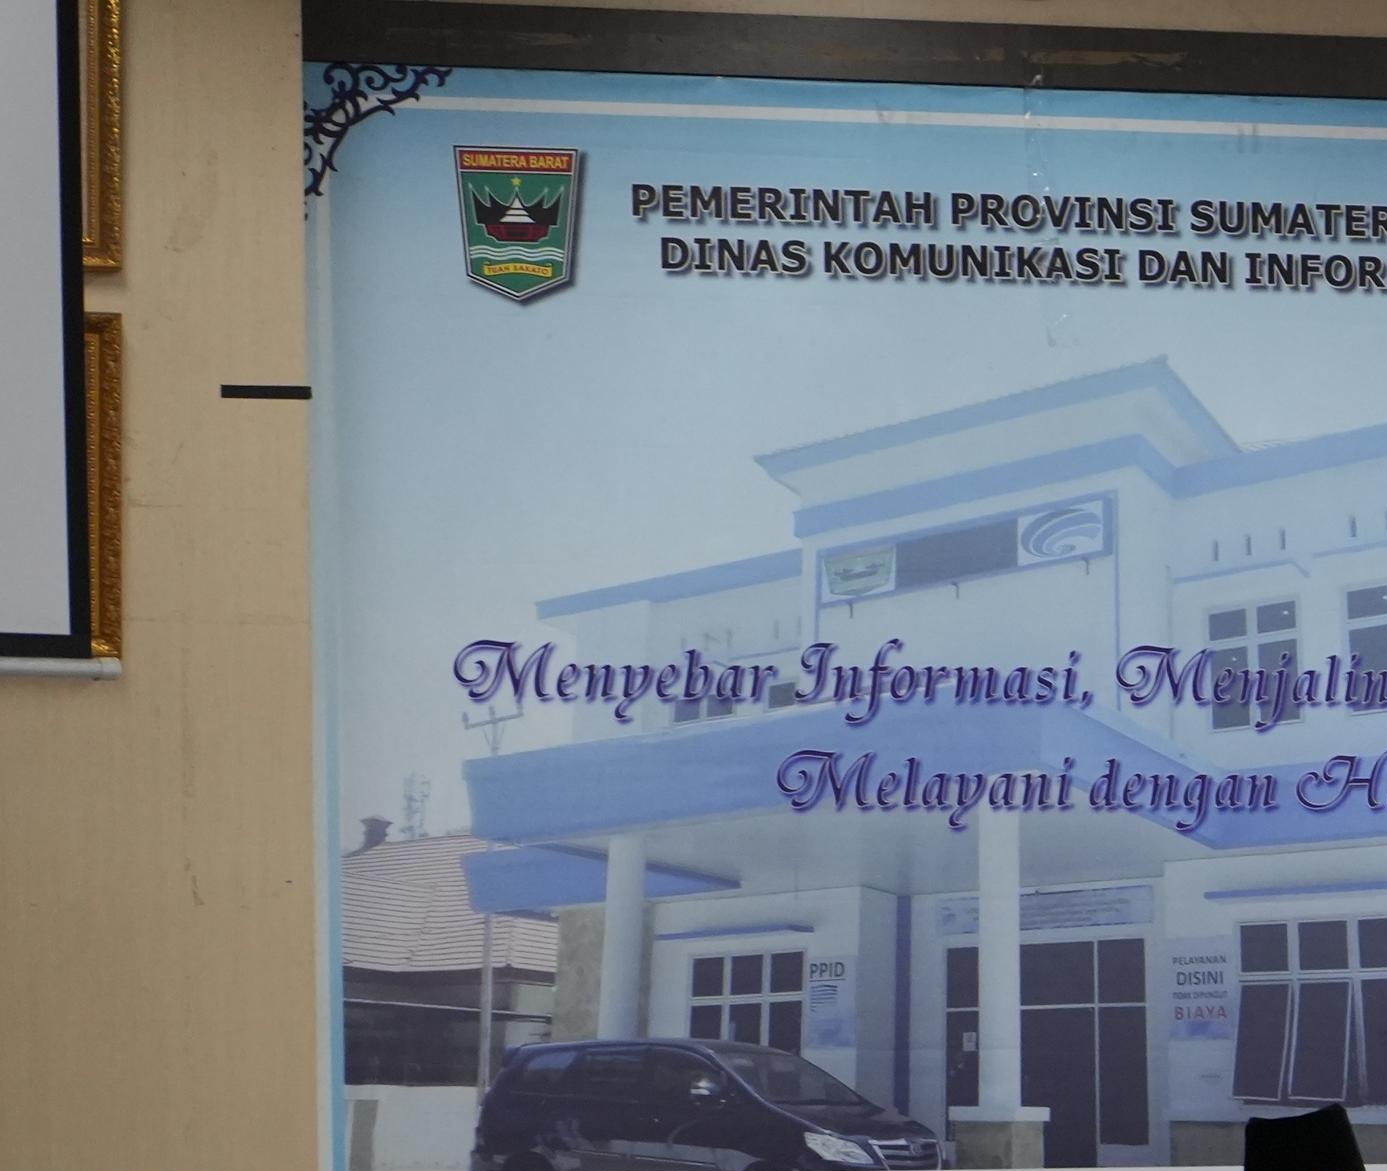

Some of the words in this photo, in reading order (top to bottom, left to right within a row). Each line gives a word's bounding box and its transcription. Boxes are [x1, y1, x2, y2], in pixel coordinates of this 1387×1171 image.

[463, 153, 526, 168] SUMATERA
[529, 155, 569, 169] BARAT
[631, 183, 934, 226] PEMERINTAH
[952, 193, 1175, 233] PROVINSI
[660, 237, 807, 274] DINAS
[823, 242, 1122, 283] KOMUNIKASI
[1138, 248, 1230, 285] DAN
[453, 638, 778, 723] Menyebar
[795, 637, 1094, 726] Informasi,
[776, 748, 1074, 830] Melayani
[1089, 757, 1278, 831] dengan
[809, 962, 845, 978] PPID
[1176, 971, 1224, 985] DISINI
[1174, 1006, 1227, 1020] BIAYA
